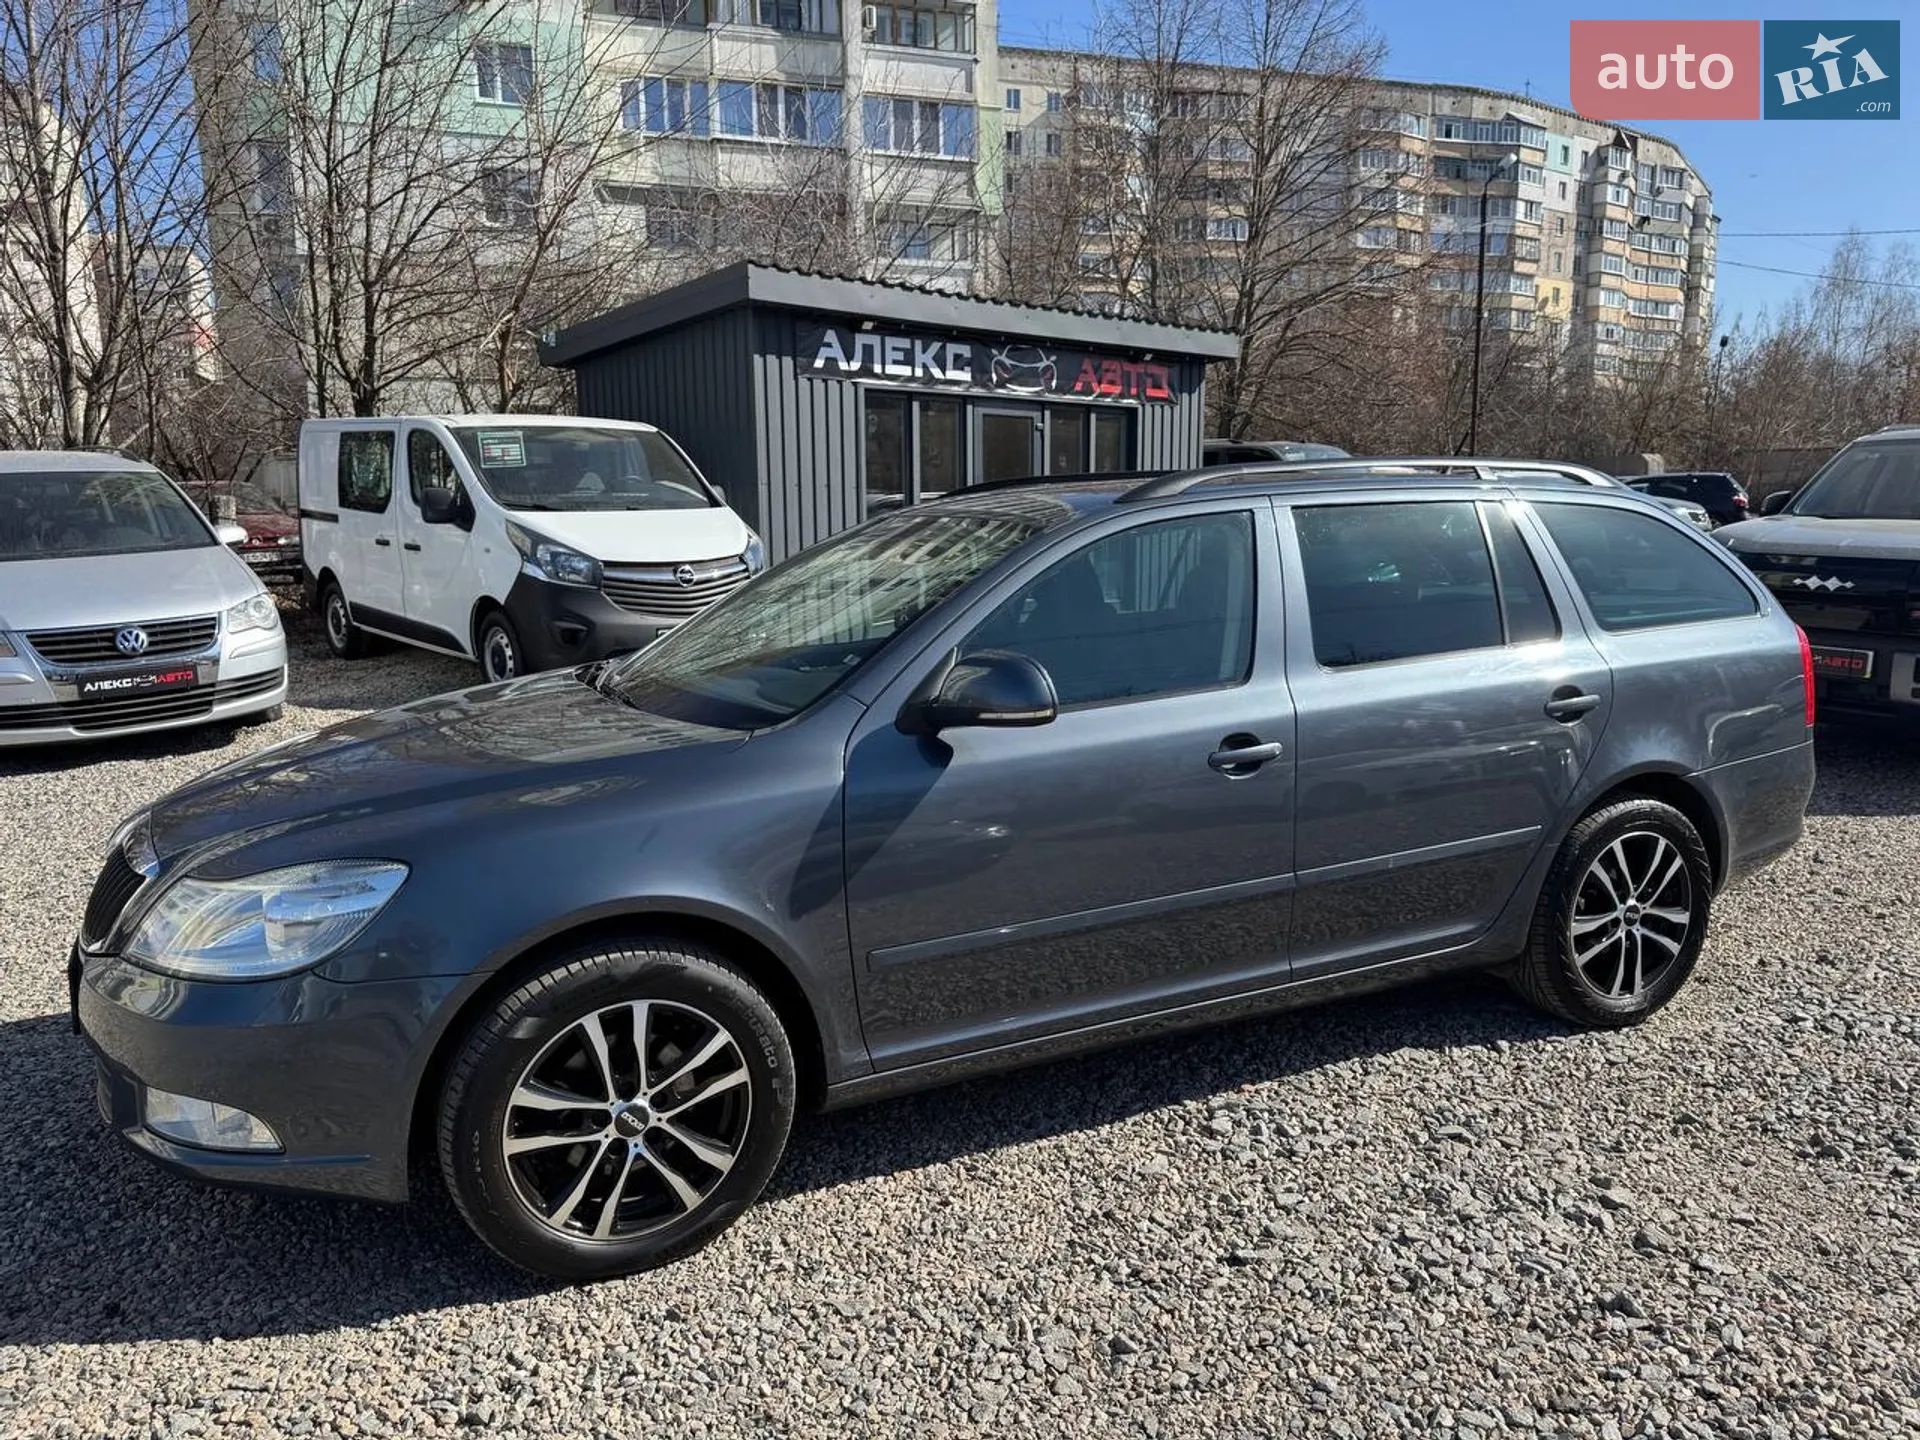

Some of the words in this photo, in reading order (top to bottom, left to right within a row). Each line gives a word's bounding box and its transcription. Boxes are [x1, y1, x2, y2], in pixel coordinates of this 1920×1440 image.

[813, 328, 972, 382] АЛЕКС
[1073, 358, 1169, 398] АВТО
[84, 678, 132, 692] АЛЕКС
